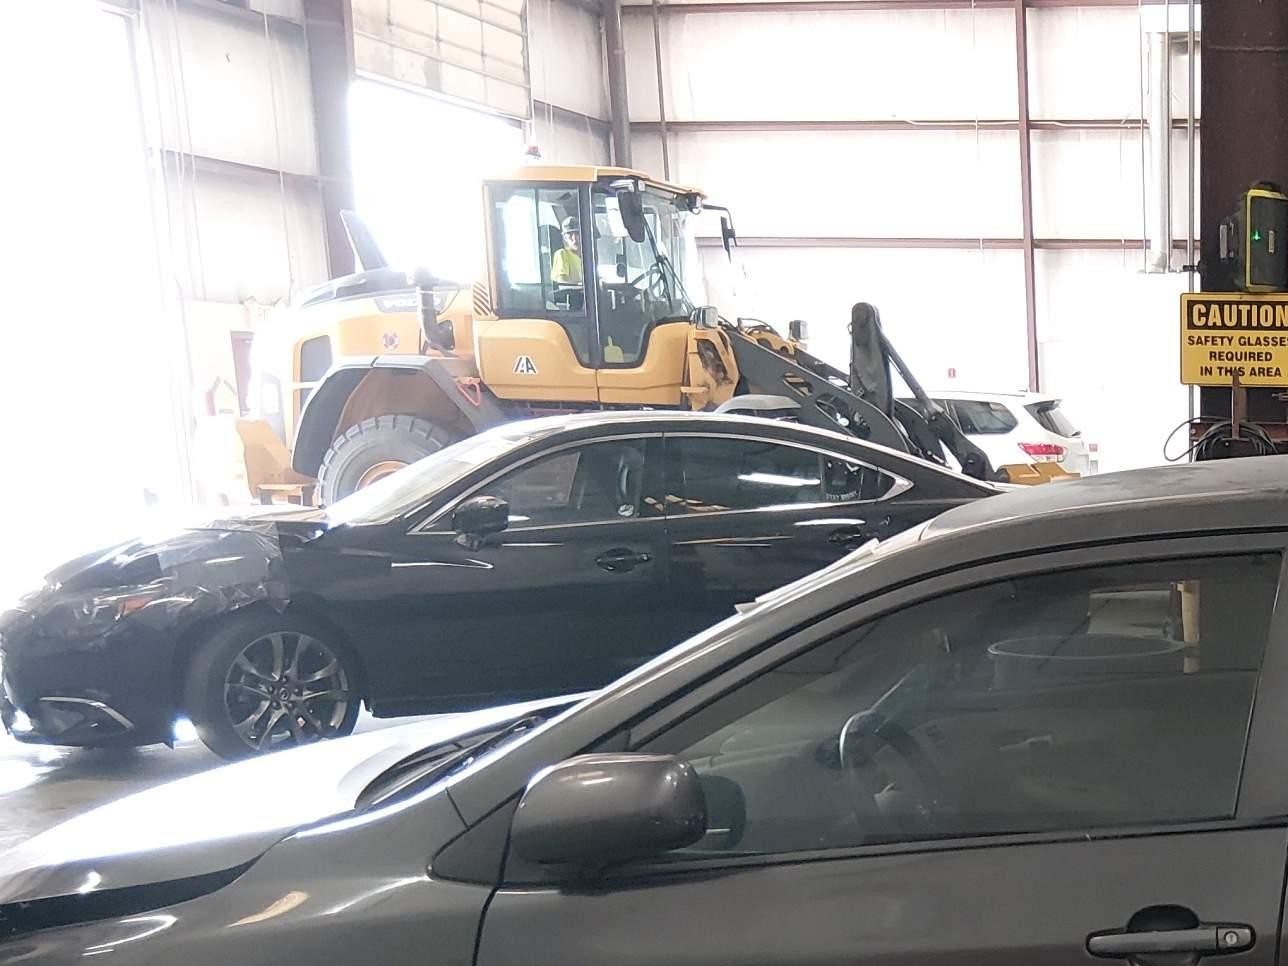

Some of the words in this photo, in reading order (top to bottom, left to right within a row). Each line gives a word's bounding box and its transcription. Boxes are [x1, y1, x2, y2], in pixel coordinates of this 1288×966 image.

[1187, 335, 1234, 346] SAFETY
[1209, 351, 1273, 362] REQUIRED
[1200, 366, 1213, 376] IN
[1249, 367, 1282, 377] AREA
